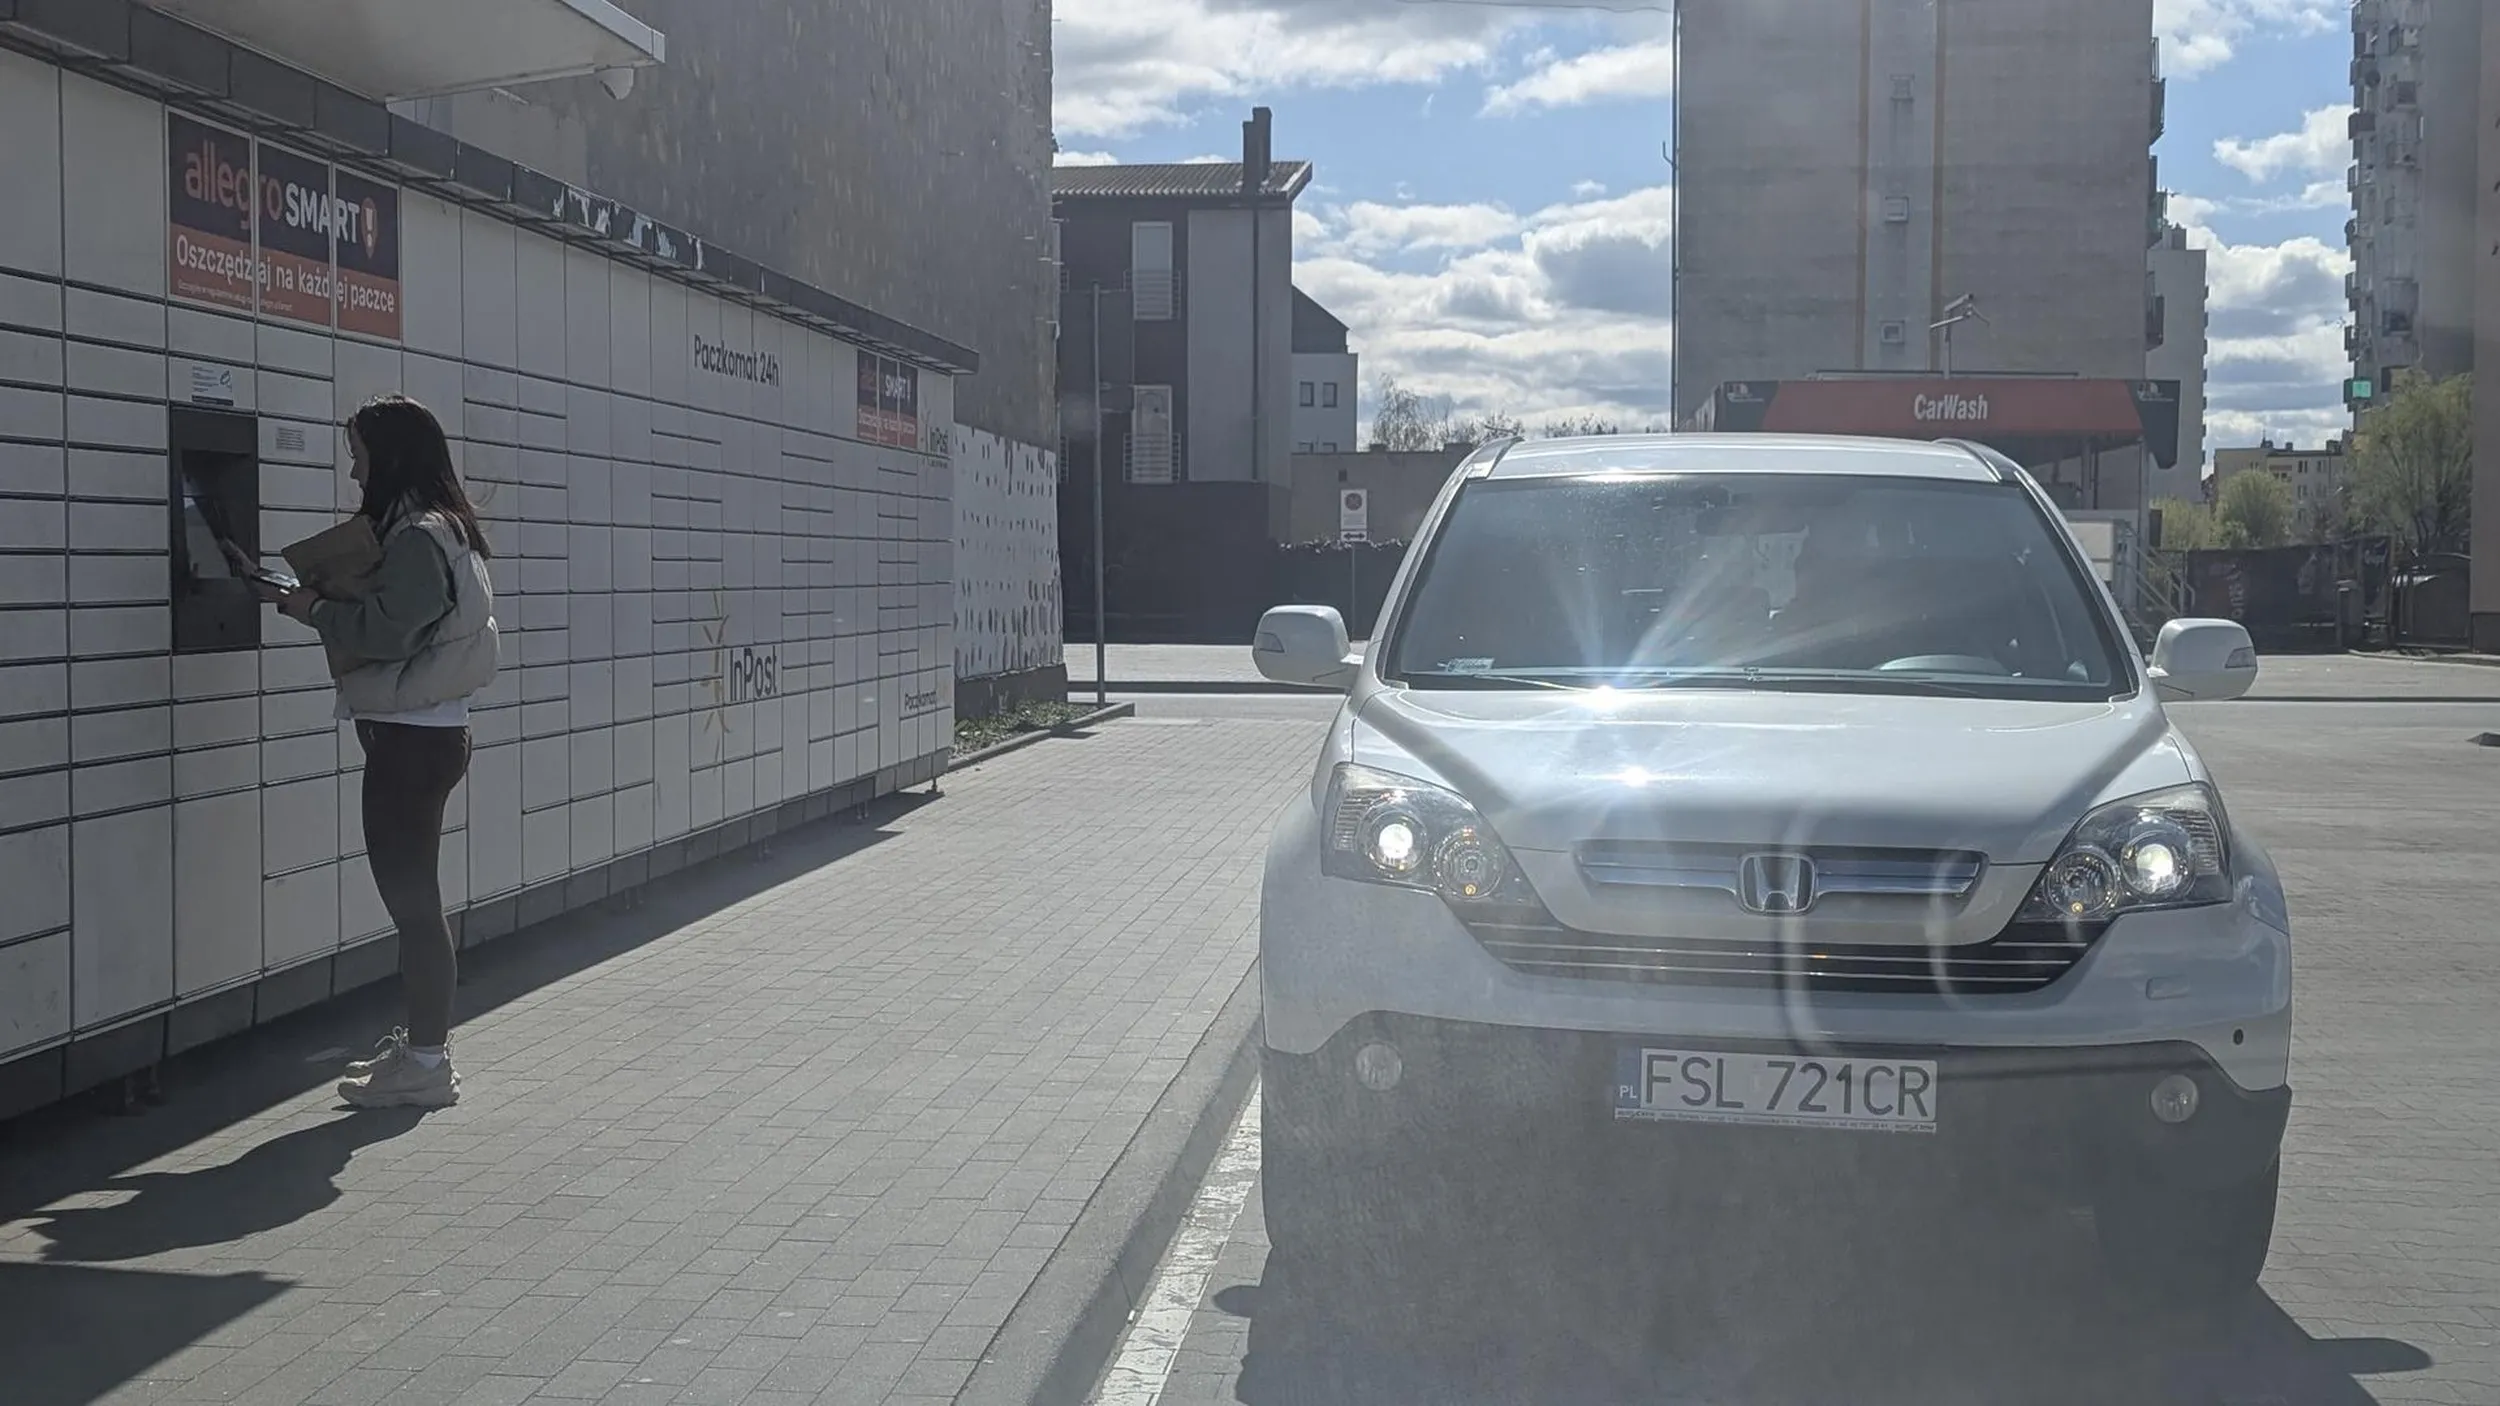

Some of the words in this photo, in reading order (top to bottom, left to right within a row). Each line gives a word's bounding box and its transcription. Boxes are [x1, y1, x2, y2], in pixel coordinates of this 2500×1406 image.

[185, 139, 283, 230] allegro
[176, 234, 272, 292] Oszczędzaj
[276, 265, 294, 291] na
[298, 263, 348, 308] każdej
[351, 284, 395, 314] paczce
[694, 333, 758, 382] Paczkomat
[760, 351, 779, 387] 24h
[1914, 393, 1988, 420] CarWash
[730, 645, 778, 702] InPost
[1619, 1085, 1638, 1099] PL
[1645, 1054, 1745, 1109] FSL
[1765, 1061, 1930, 1118] 721CR
